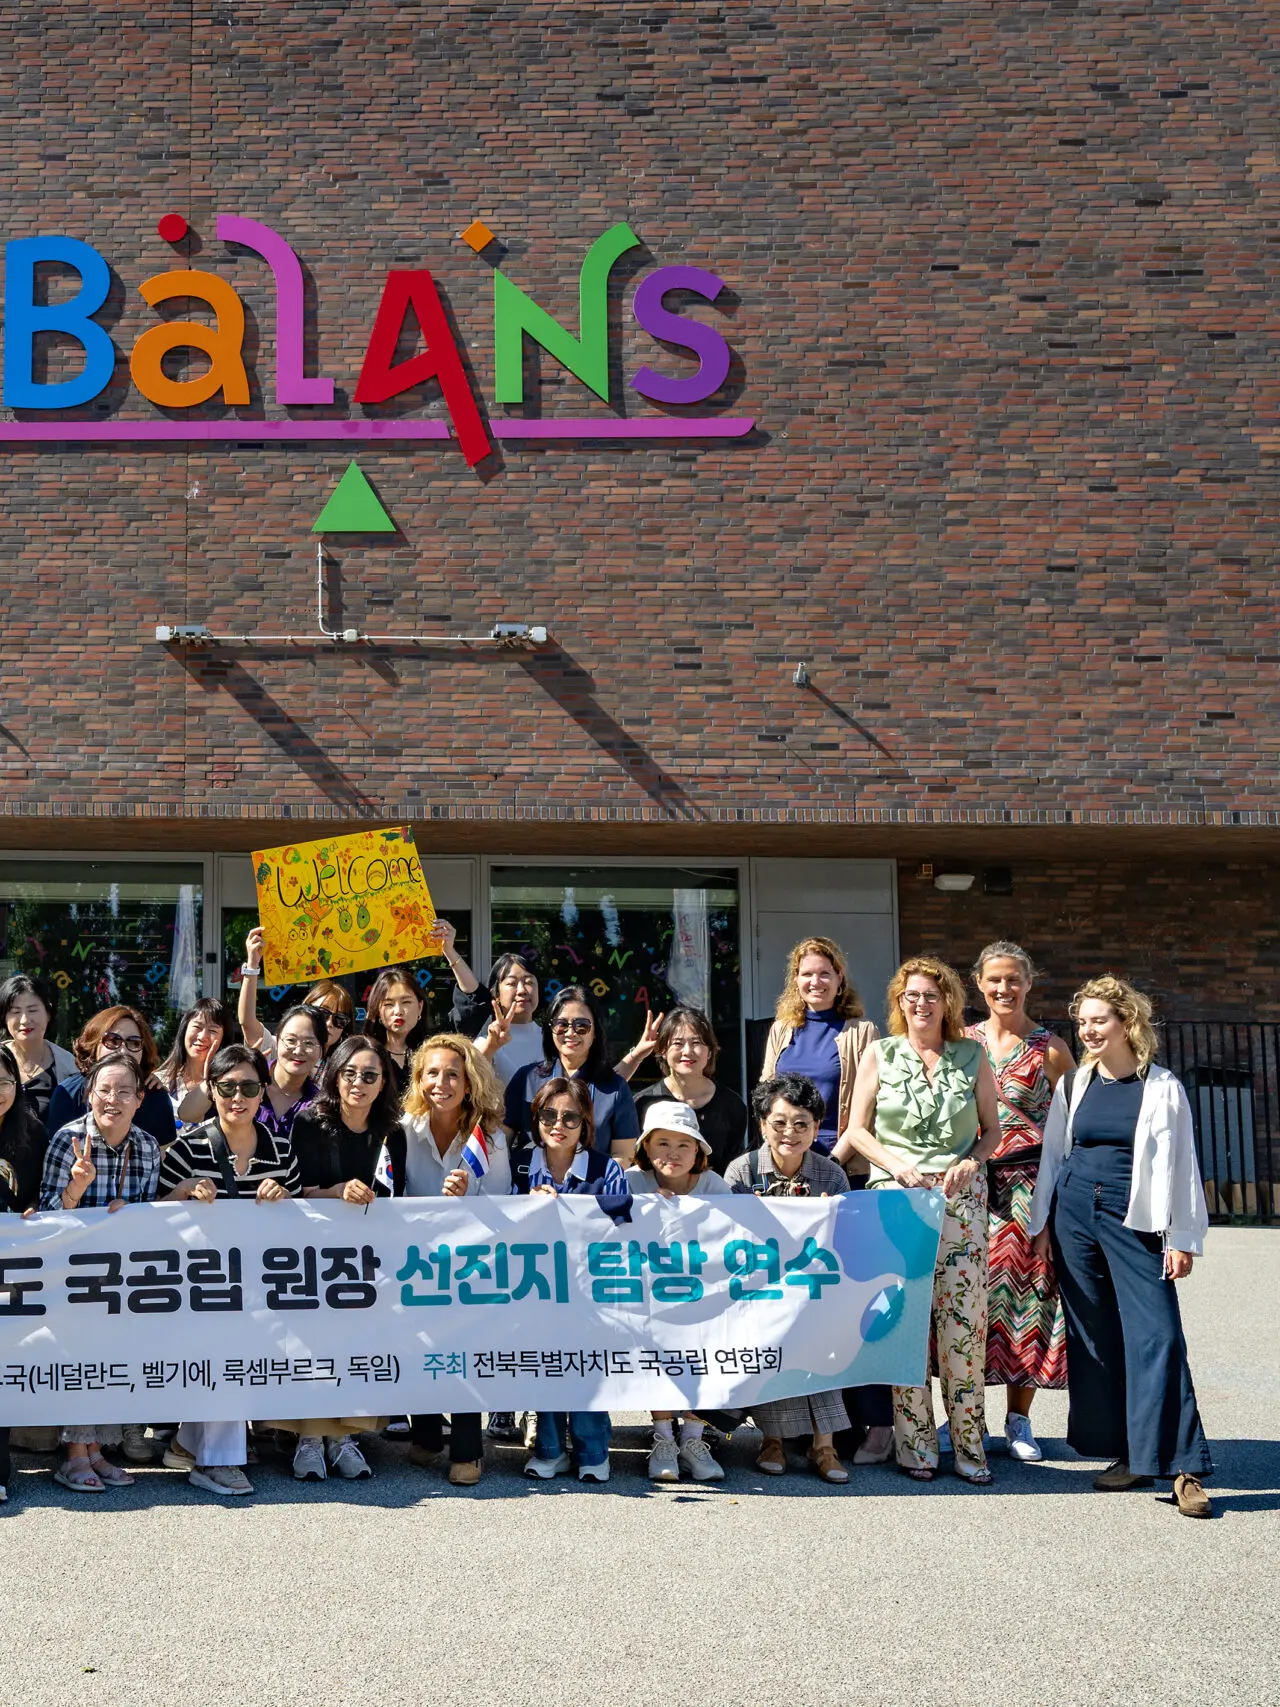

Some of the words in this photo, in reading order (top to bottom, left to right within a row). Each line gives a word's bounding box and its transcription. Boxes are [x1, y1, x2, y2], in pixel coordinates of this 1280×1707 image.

[65, 1246, 244, 1314] 국공립
[261, 1244, 382, 1312] 원장
[396, 1240, 569, 1306] 선진지
[587, 1239, 708, 1303] 탐방
[723, 1237, 841, 1301] 연수
[142, 1359, 216, 1390] 벨기에,
[222, 1356, 341, 1386] 룩셈부르크,
[347, 1353, 401, 1384] 독일)
[423, 1351, 467, 1381] 주최
[472, 1349, 634, 1379] 전북특별자치도
[638, 1348, 708, 1376] 국공립
[714, 1346, 783, 1374] 연합회
